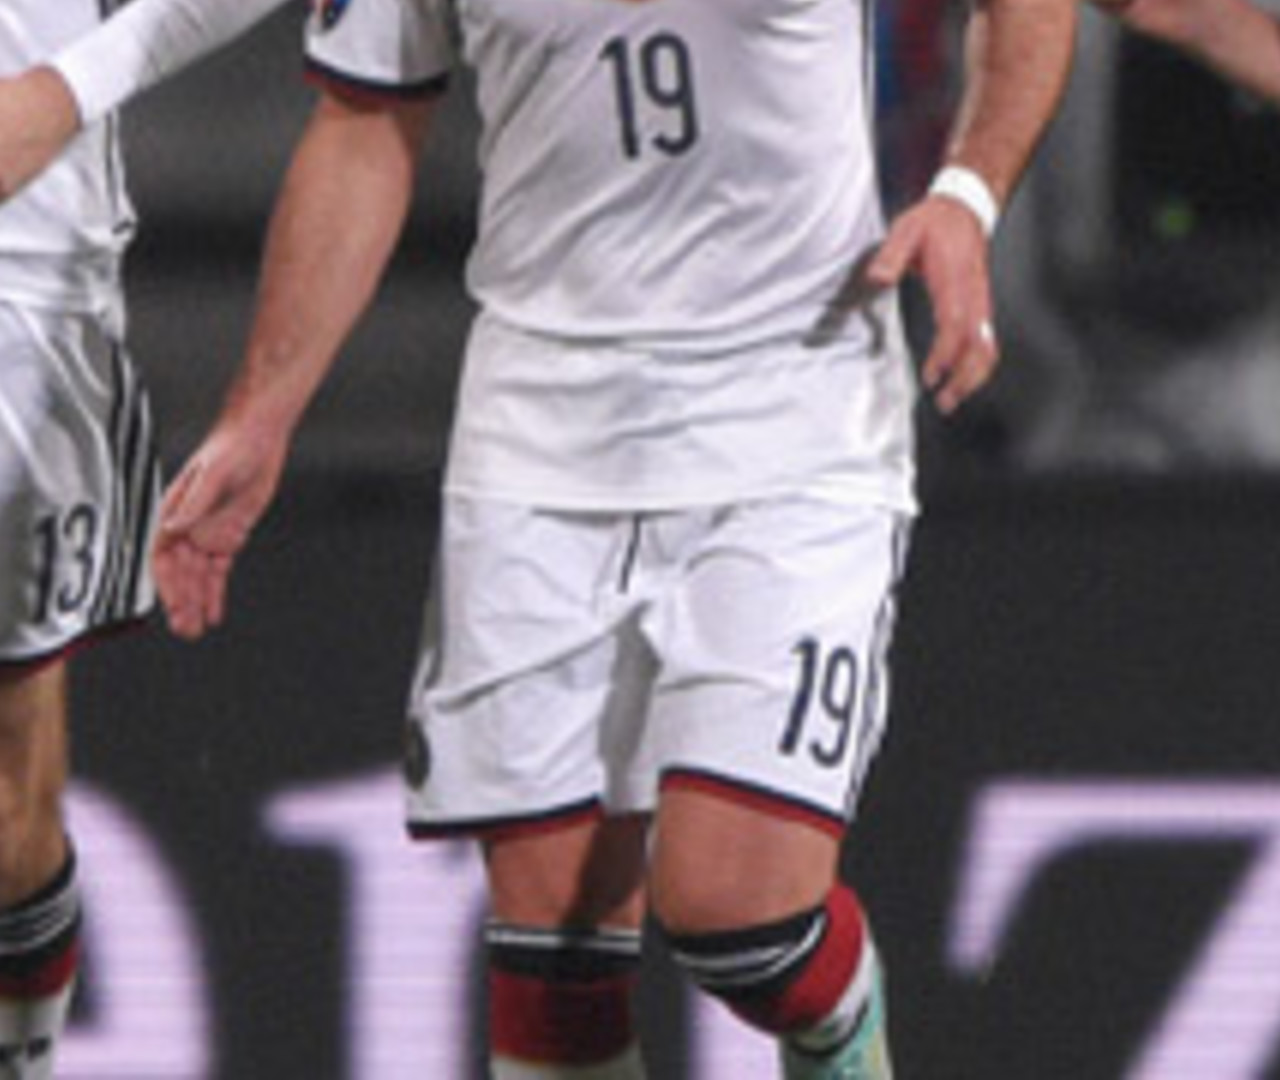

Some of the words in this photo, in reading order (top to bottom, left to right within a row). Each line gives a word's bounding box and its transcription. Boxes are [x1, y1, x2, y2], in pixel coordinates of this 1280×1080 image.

[600, 33, 699, 160] 19
[33, 503, 96, 622] 13
[779, 636, 858, 768] 19
